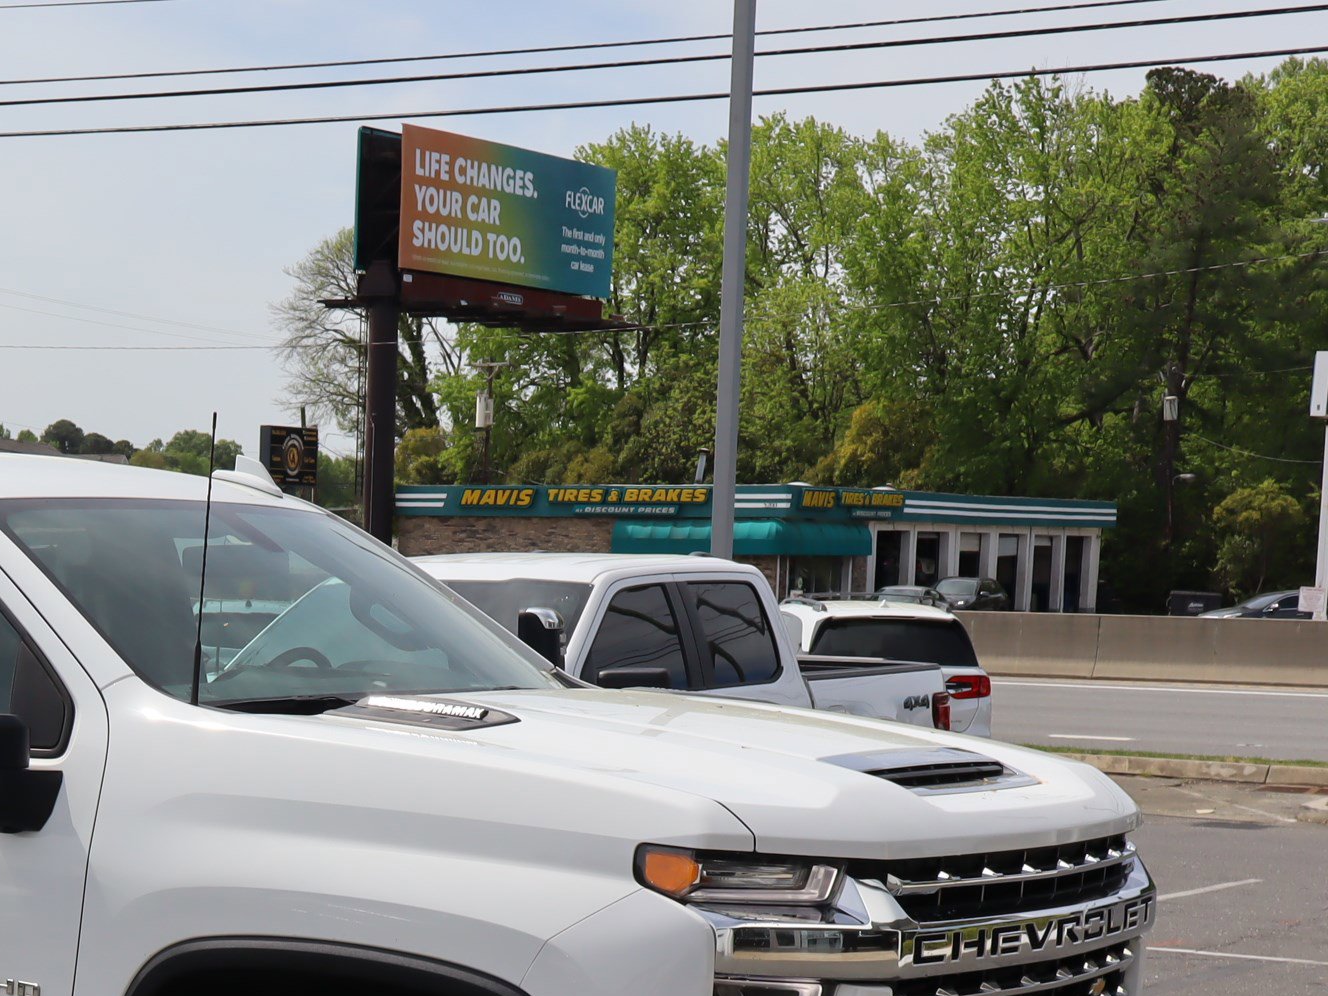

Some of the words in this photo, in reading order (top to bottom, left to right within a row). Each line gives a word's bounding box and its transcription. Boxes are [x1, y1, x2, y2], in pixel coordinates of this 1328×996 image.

[415, 148, 450, 181] LIFE
[454, 157, 538, 199] CHANGES.
[414, 183, 463, 219] YOUR
[466, 195, 501, 226] CAR
[565, 190, 605, 215] FLEXCAR
[412, 219, 483, 256] SHOULD
[487, 232, 525, 264] TOO.
[562, 226, 572, 238] The
[573, 228, 583, 240] first
[584, 231, 594, 243] and
[594, 233, 606, 246] only
[561, 244, 605, 259] month-to-month
[460, 489, 534, 506] MAVIS
[547, 489, 604, 502] TIRES
[608, 490, 620, 502] &
[624, 489, 708, 502] BRAKES
[802, 490, 836, 508] MAVIS
[841, 492, 864, 505] TIRES
[871, 493, 904, 507] BRAKES
[584, 506, 635, 514] DISCOUNT
[912, 897, 1153, 967] CHEVROLET
